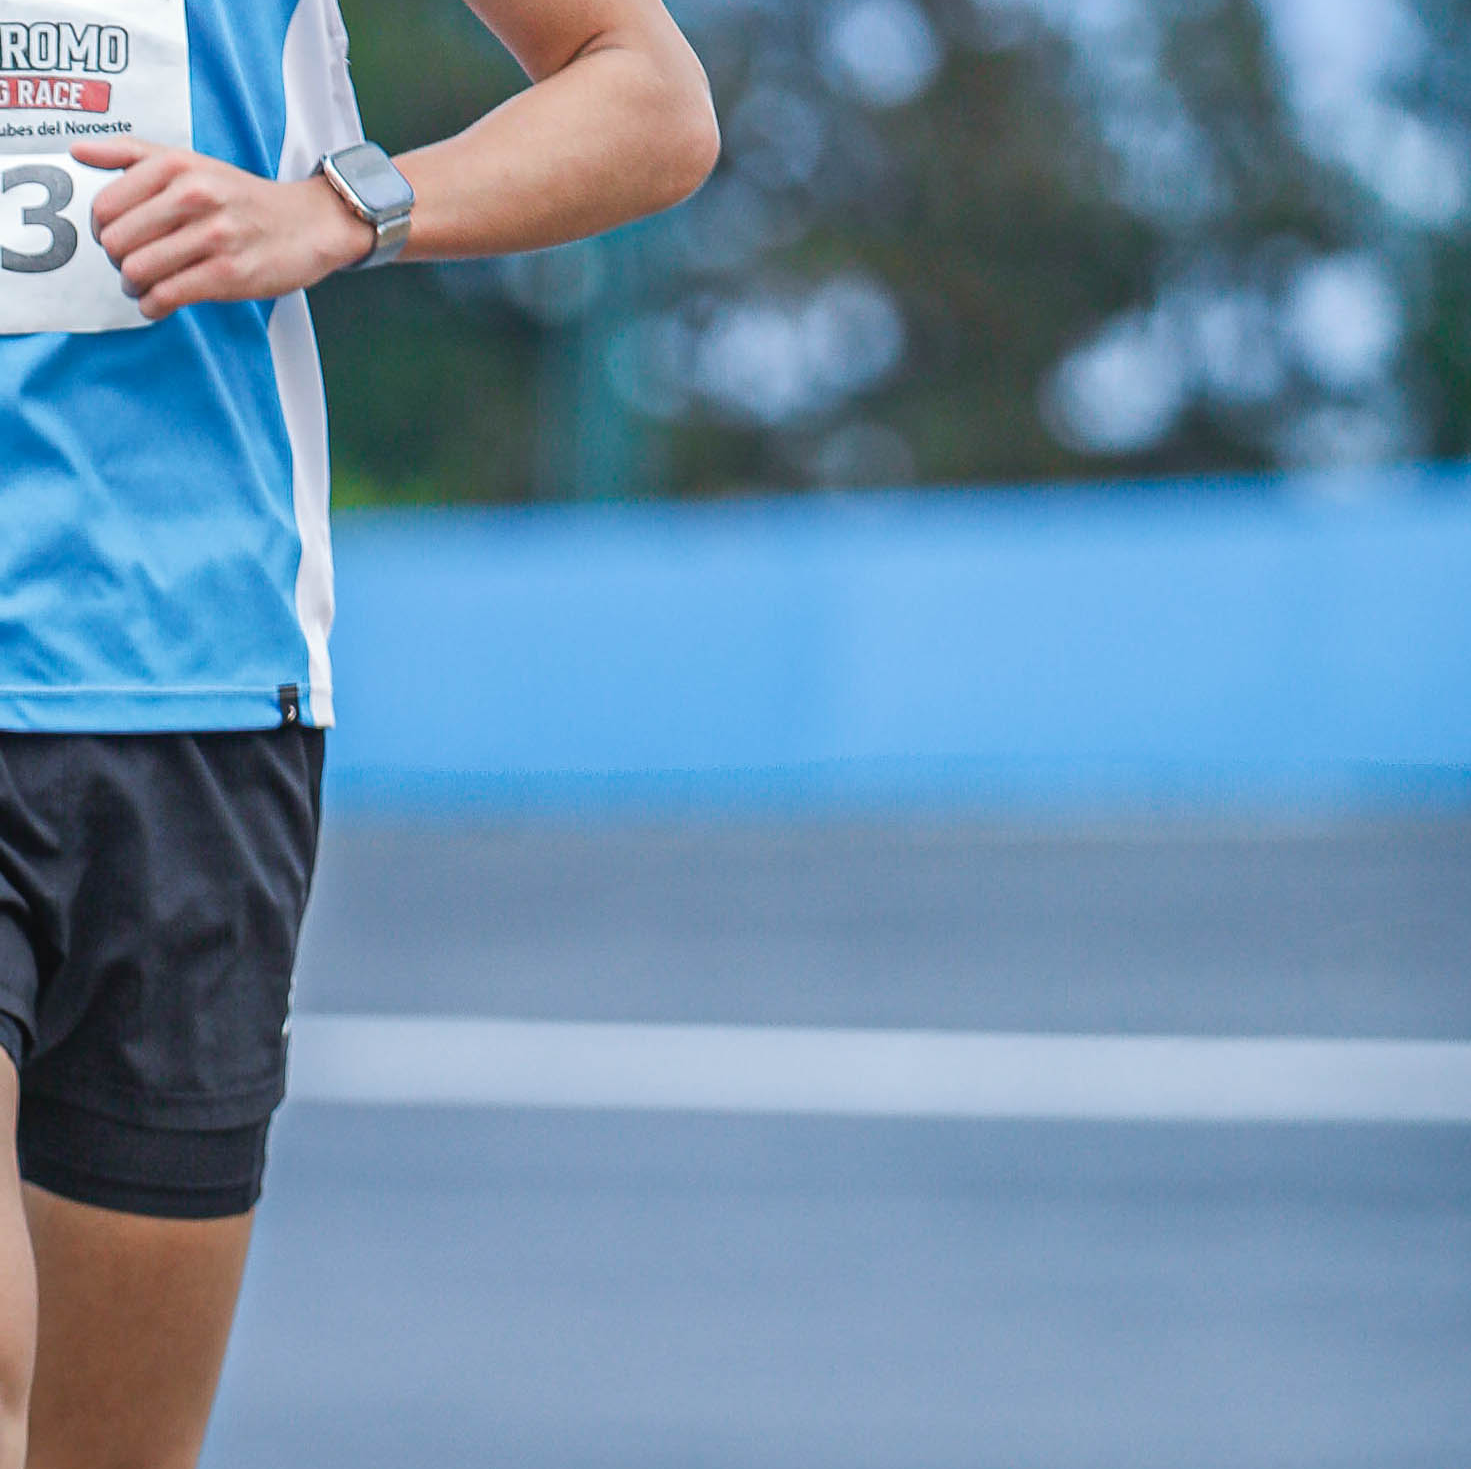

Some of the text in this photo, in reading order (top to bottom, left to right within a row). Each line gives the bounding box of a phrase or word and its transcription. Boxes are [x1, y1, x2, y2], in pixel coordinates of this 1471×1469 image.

[17, 79, 85, 110] RACE
[37, 120, 60, 136] del
[64, 120, 133, 135] Noroeste
